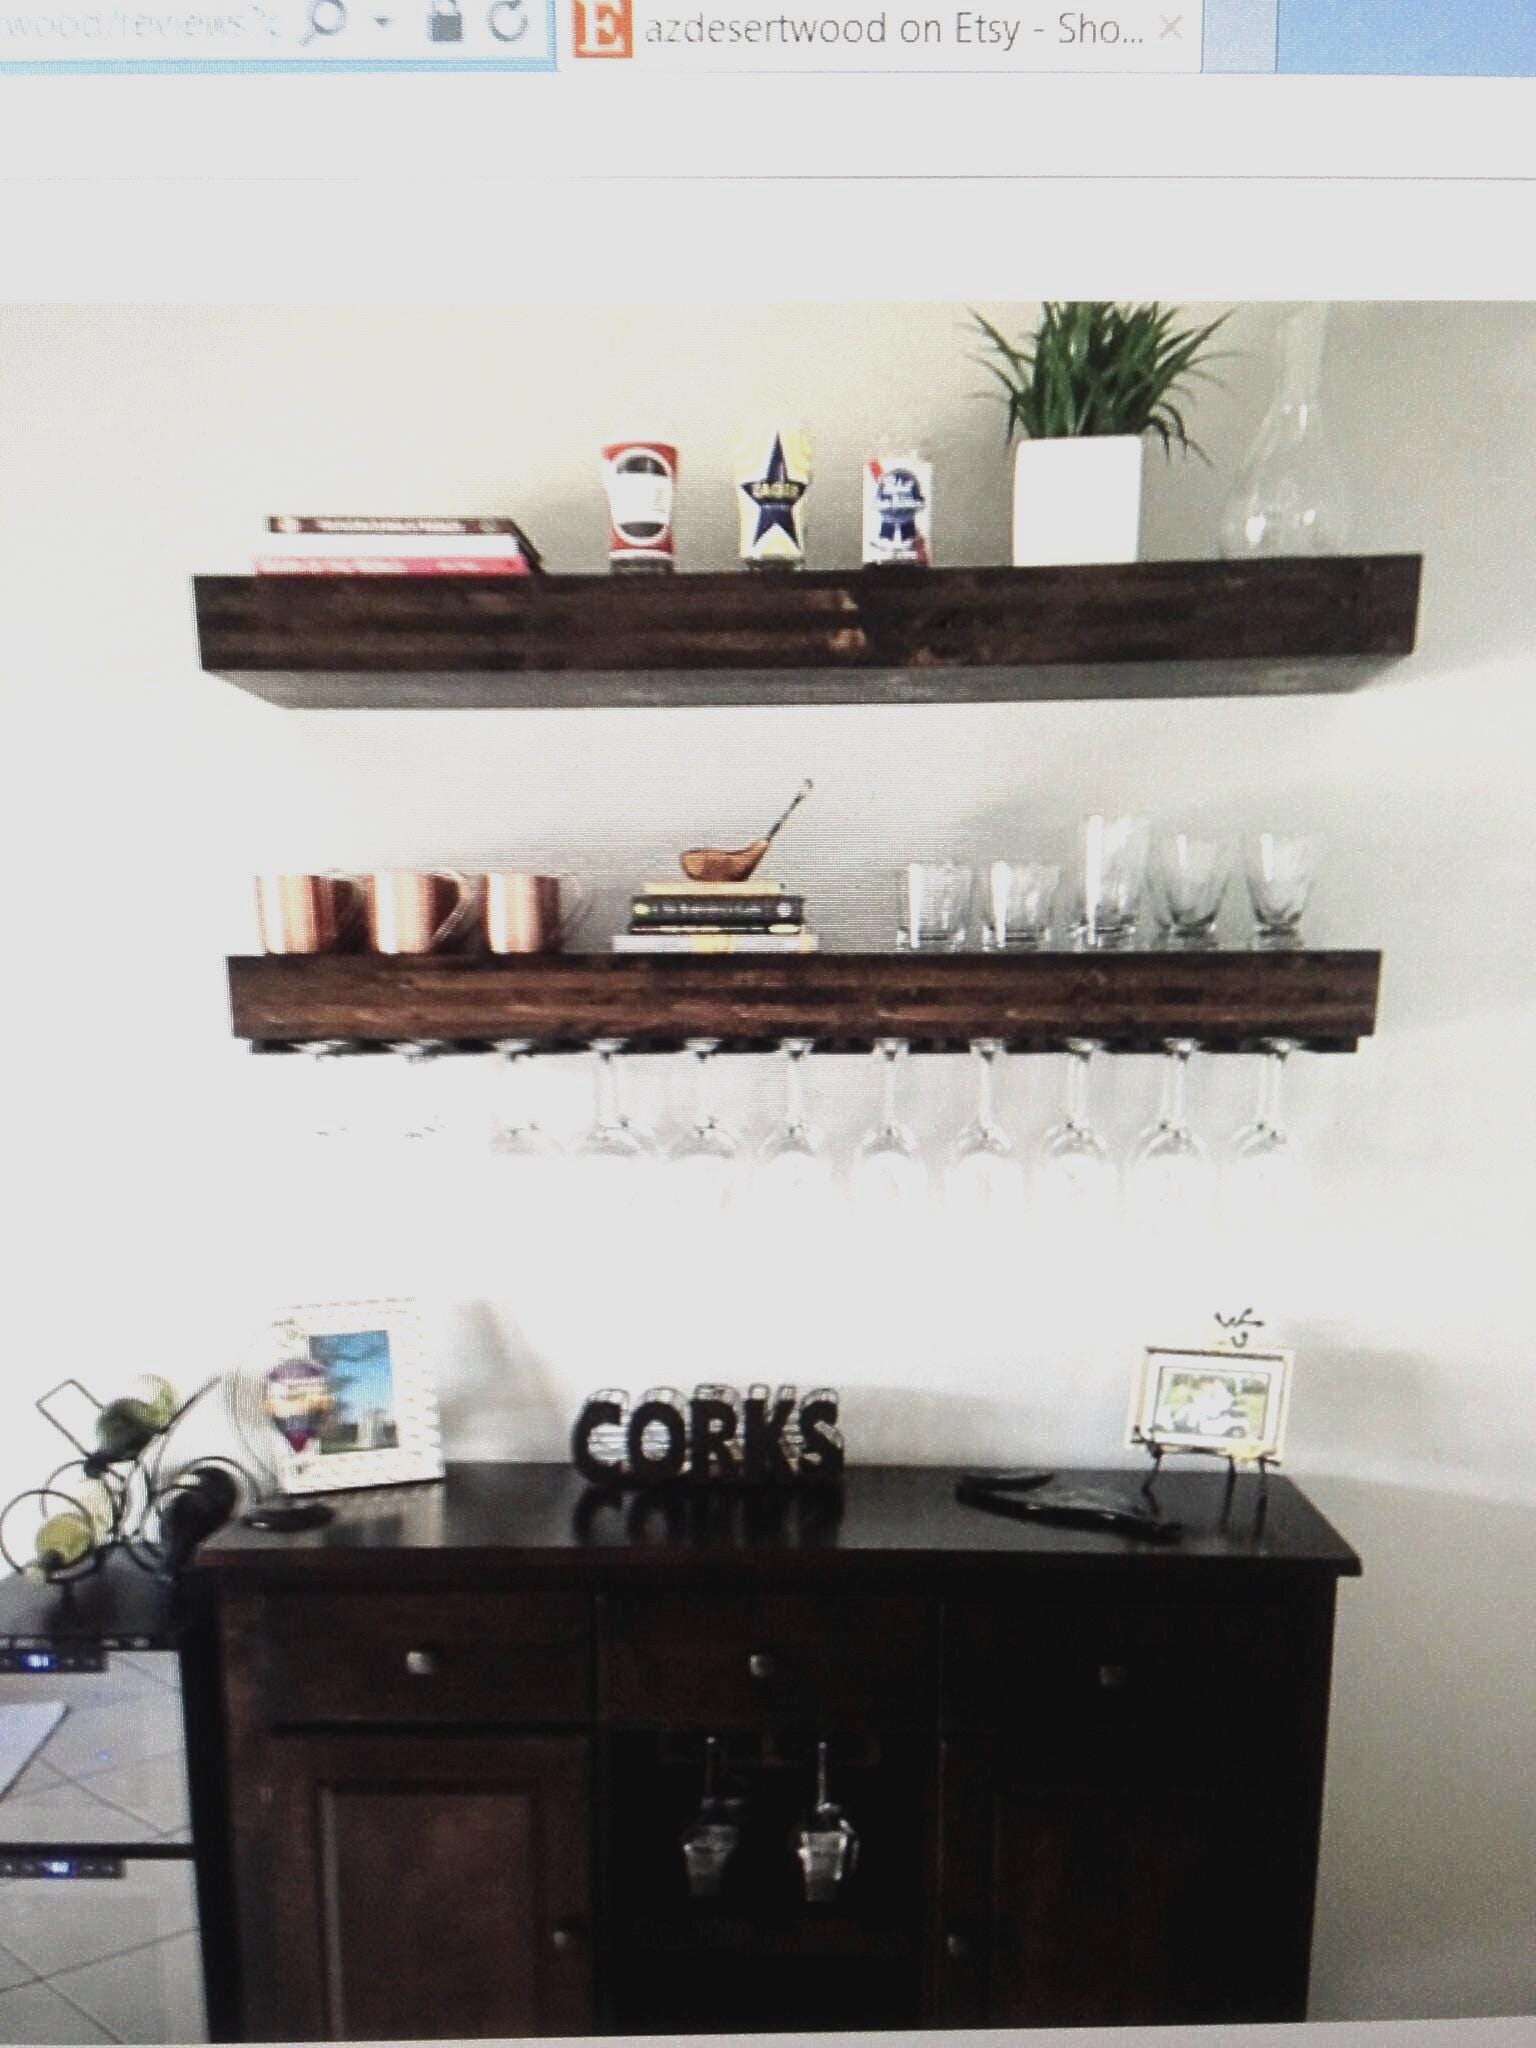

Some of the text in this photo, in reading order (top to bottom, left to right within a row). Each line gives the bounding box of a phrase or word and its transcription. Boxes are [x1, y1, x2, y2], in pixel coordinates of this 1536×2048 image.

[579, 0, 625, 52] E
[646, 12, 886, 43] azdesertwood
[900, 20, 941, 43] on
[956, 12, 1021, 51] Etsy
[571, 1383, 845, 1483] CORKS
